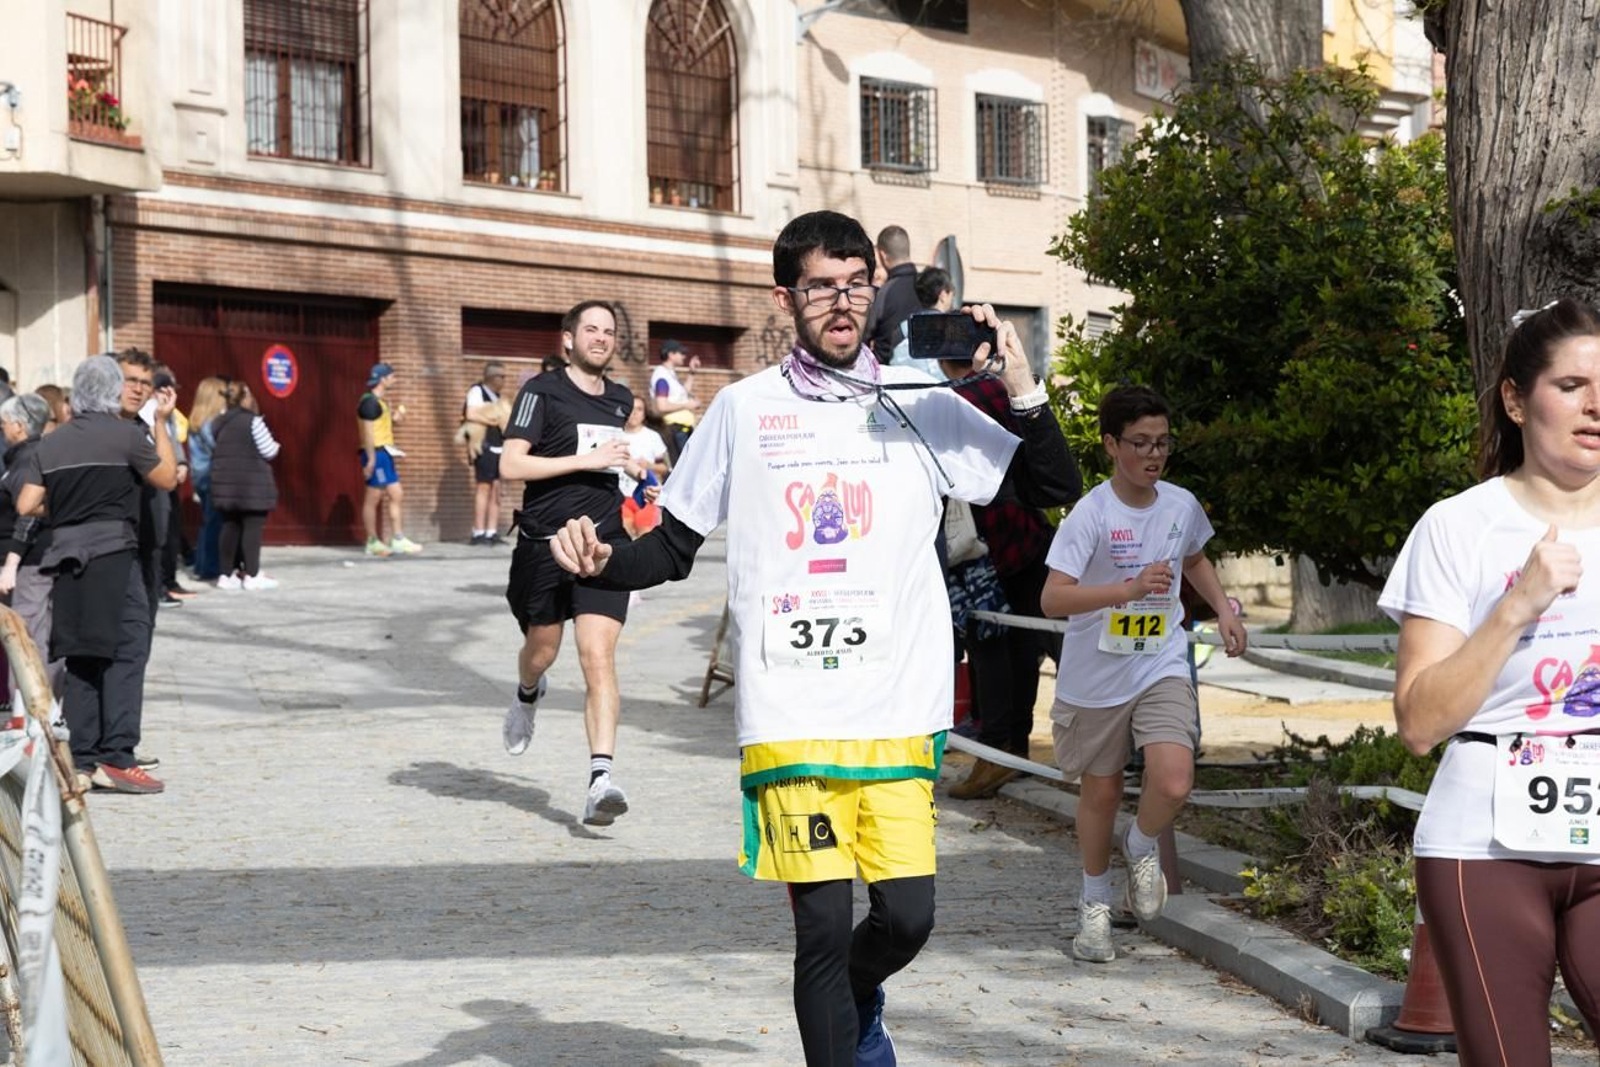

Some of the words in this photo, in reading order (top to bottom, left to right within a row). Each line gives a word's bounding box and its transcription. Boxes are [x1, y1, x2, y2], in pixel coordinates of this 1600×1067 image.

[758, 415, 799, 430] XXVII
[790, 618, 867, 649] 373
[1118, 615, 1161, 637] 112
[1528, 775, 1600, 816] 95
